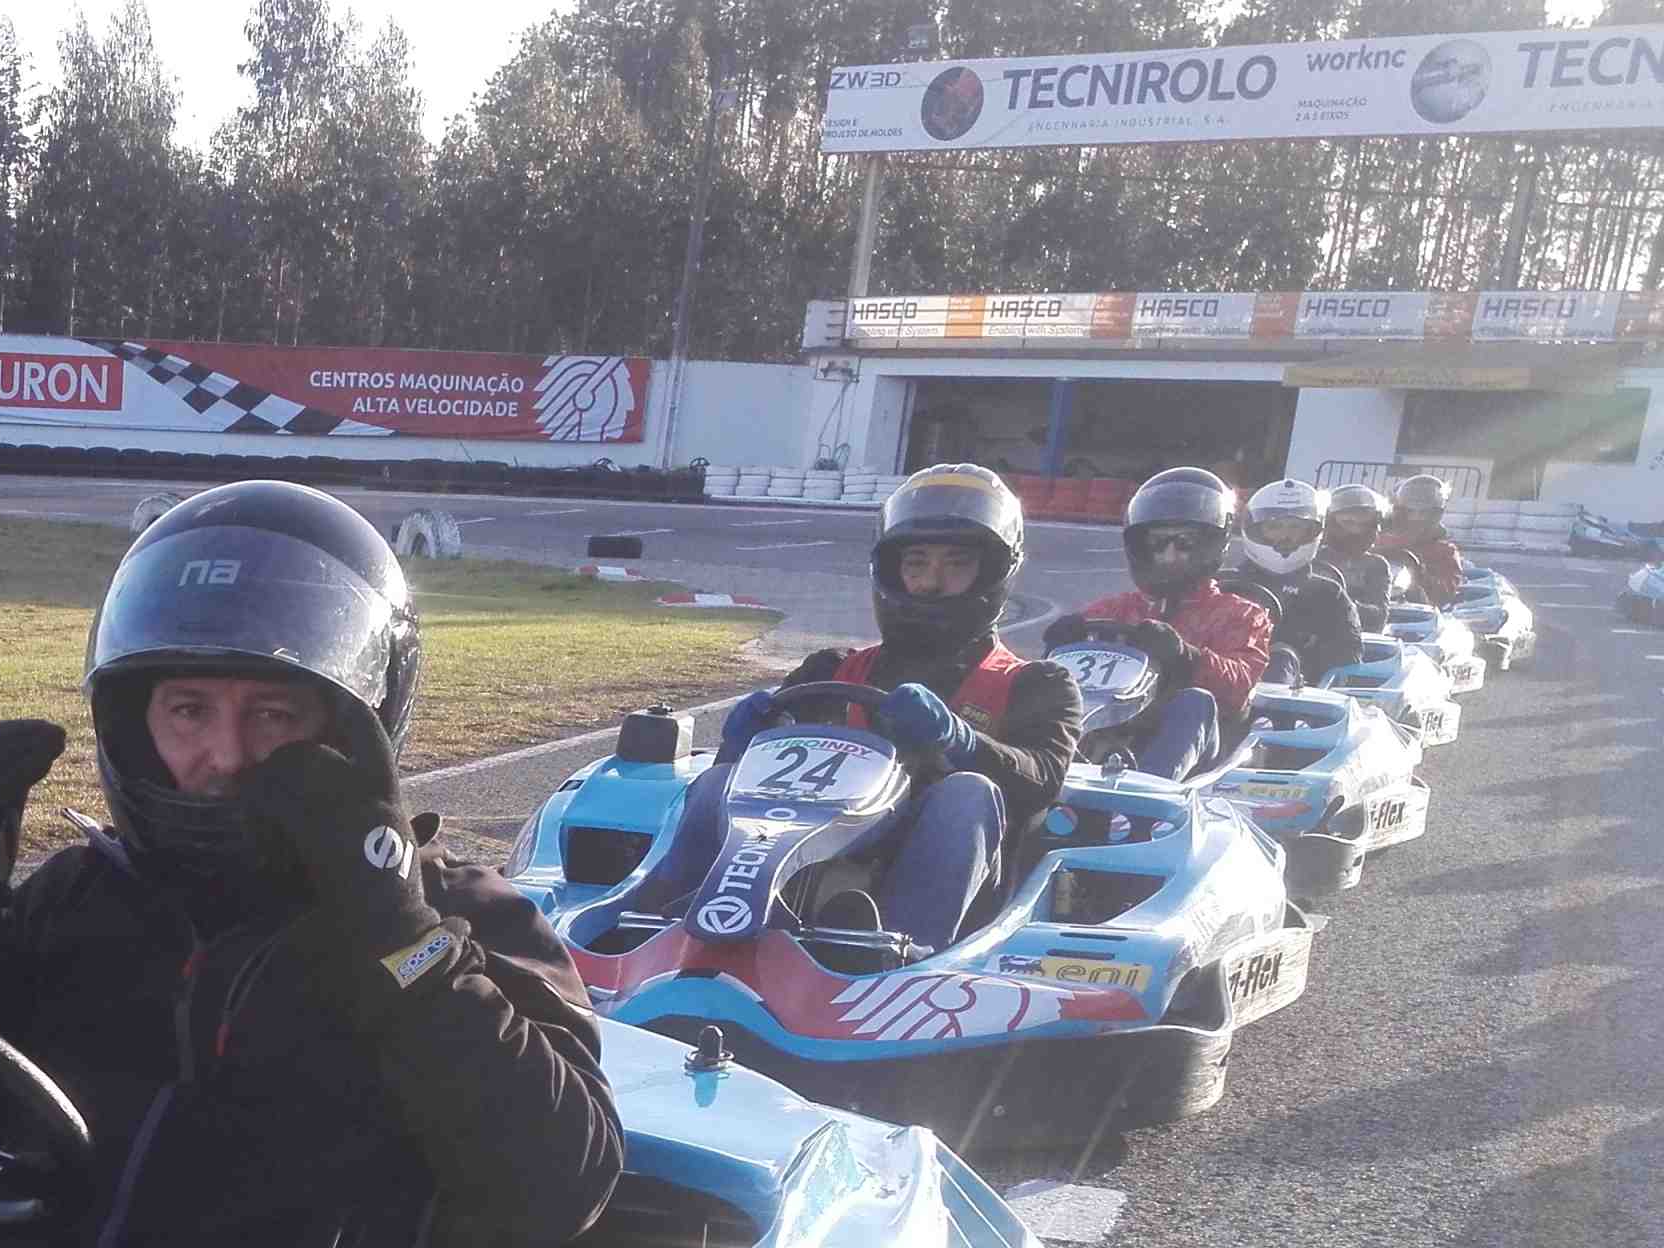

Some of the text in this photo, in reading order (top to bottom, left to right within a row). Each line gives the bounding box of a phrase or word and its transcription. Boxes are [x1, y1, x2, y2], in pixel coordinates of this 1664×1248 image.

[1306, 44, 1407, 73] worknc
[1516, 36, 1664, 89] TECN
[1002, 54, 1277, 111] TECNIROLO
[850, 301, 919, 320] HASCO
[990, 299, 1063, 319] HASCO
[1138, 299, 1220, 318] HASCO
[1303, 299, 1391, 317] HASCO
[309, 371, 525, 396] CENTROS MAQUINAÇÃO
[351, 397, 519, 417] ALTA VELOCIDADE
[1076, 656, 1118, 685] 31
[758, 747, 852, 792] 24
[398, 935, 450, 978] sparco
[1055, 963, 1140, 987] eni
